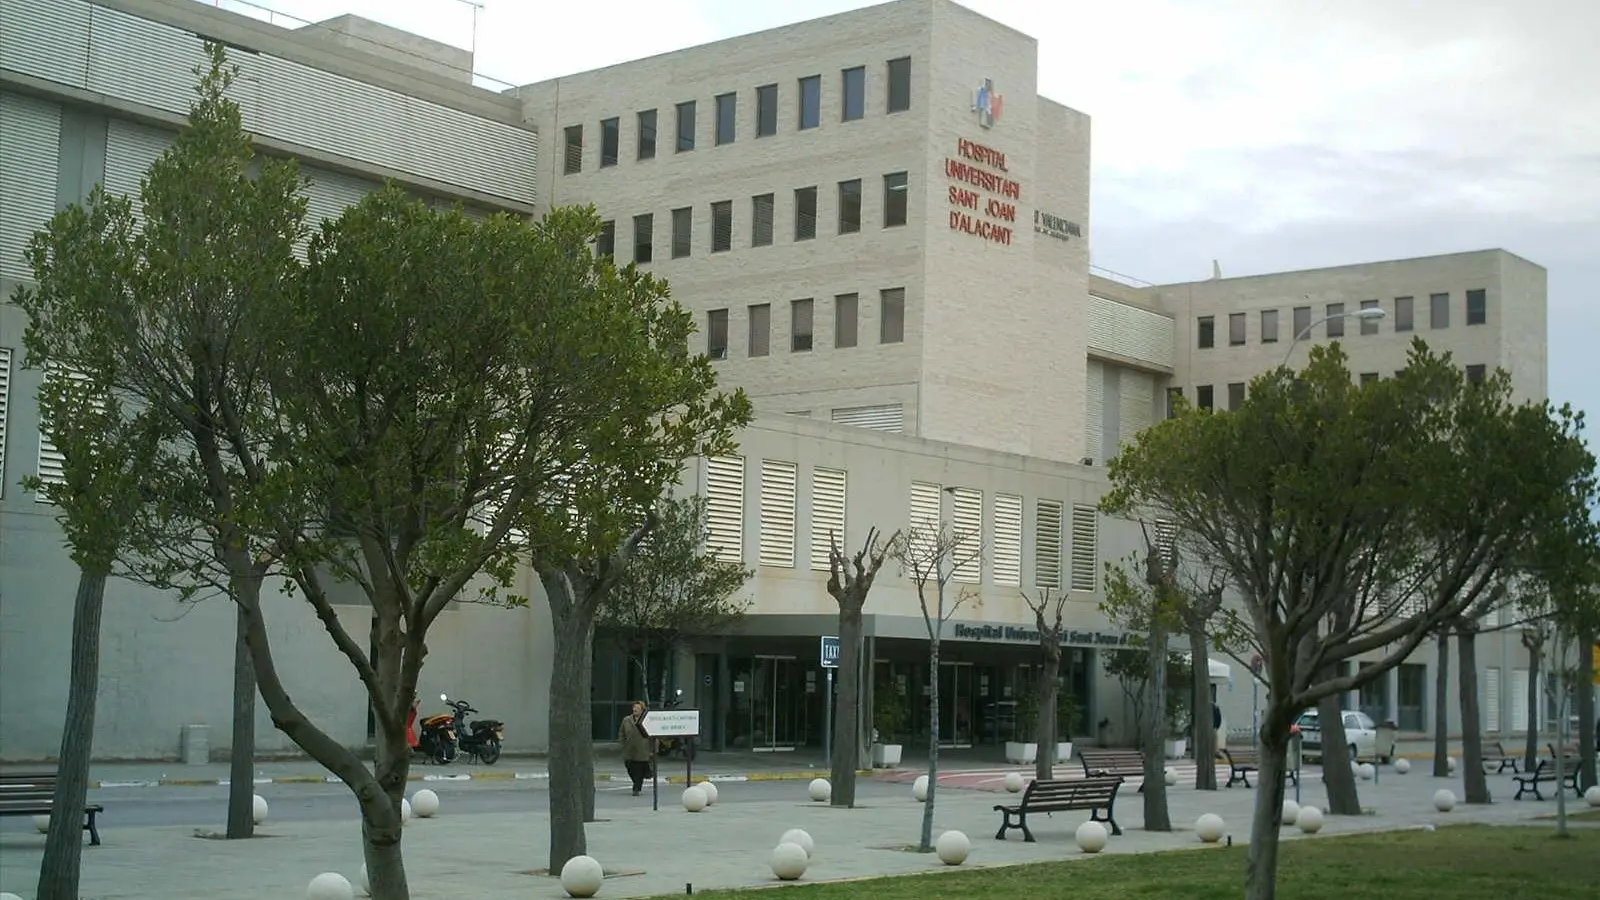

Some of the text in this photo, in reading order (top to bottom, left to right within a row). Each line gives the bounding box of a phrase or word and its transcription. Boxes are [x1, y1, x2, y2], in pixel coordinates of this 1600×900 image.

[958, 137, 1008, 172] HOSPITAL
[945, 158, 1020, 200] UNIVERSITARI
[949, 186, 980, 211] SANT
[985, 198, 1015, 222] JOAN
[950, 211, 1013, 245] D'ALACANT
[955, 623, 1003, 640] Hospital
[1070, 630, 1092, 643] Sant
